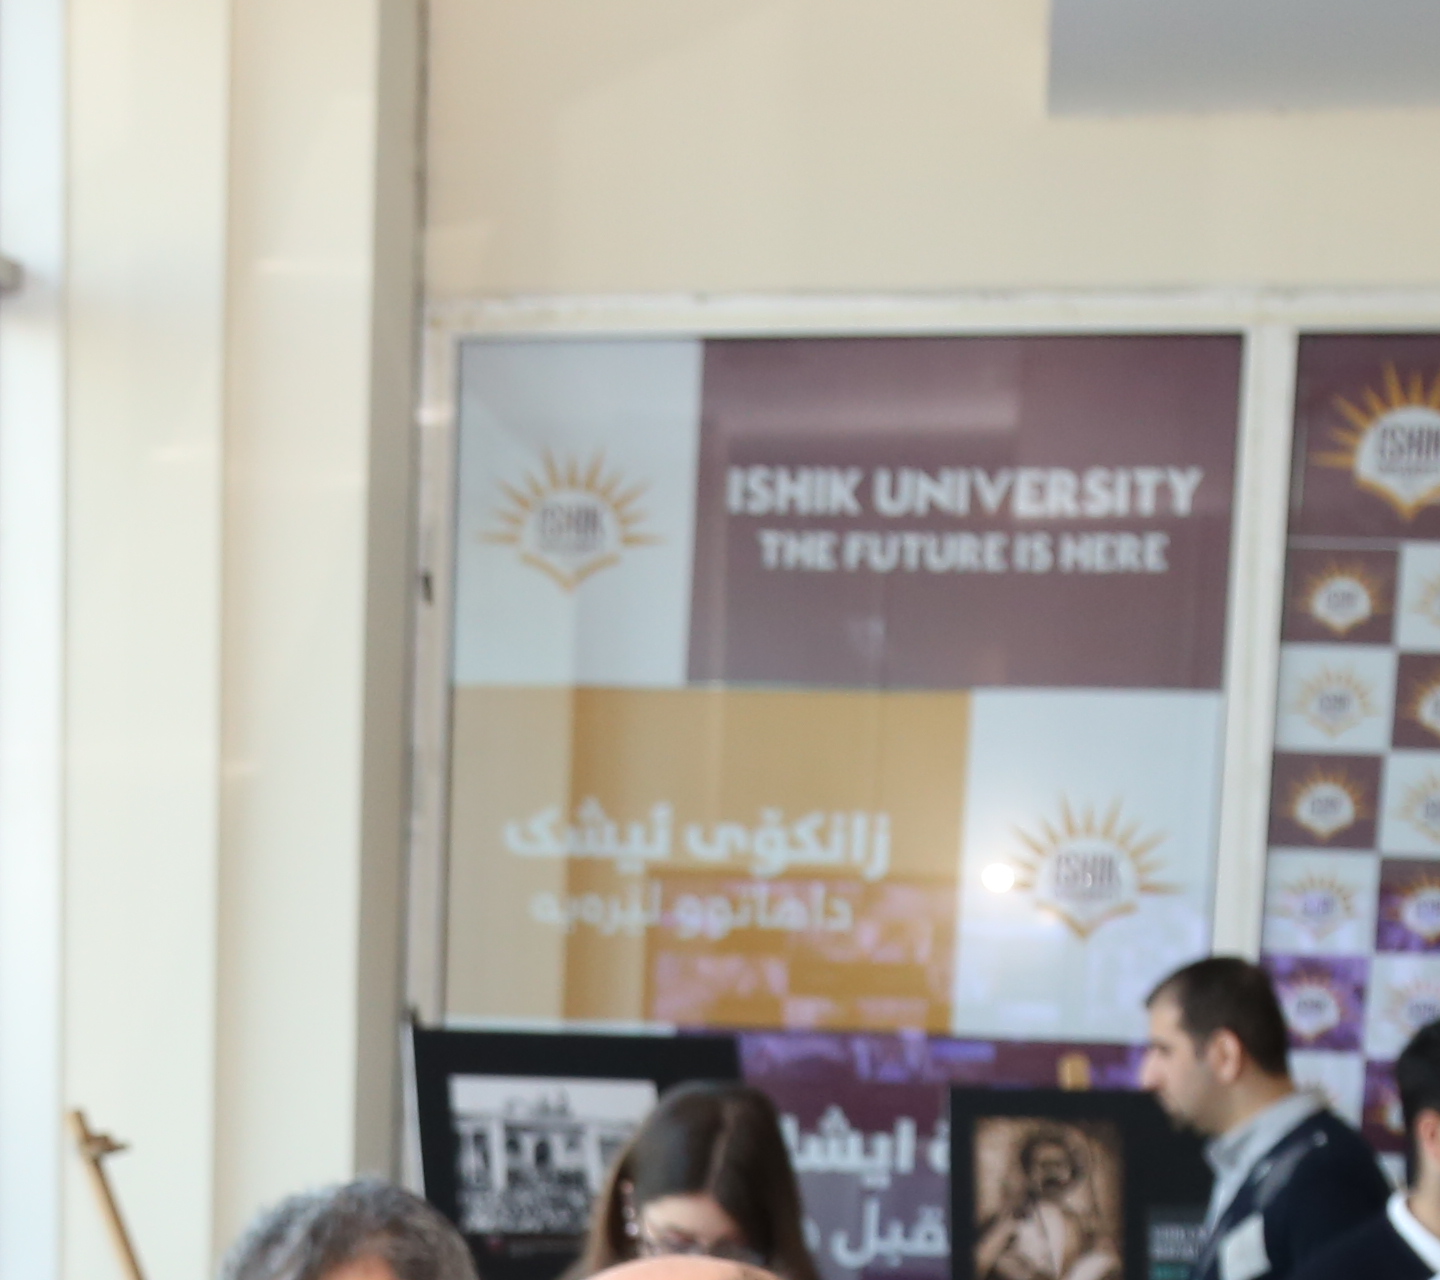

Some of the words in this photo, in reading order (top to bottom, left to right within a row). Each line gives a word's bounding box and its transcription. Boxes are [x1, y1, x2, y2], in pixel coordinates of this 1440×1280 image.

[726, 464, 864, 517] ISHIK
[872, 464, 1203, 519] UNIVERSITY
[757, 528, 837, 573] THE
[842, 529, 1006, 574] FUTURE
[1013, 531, 1052, 574] IS
[1058, 531, 1170, 574] HERE
